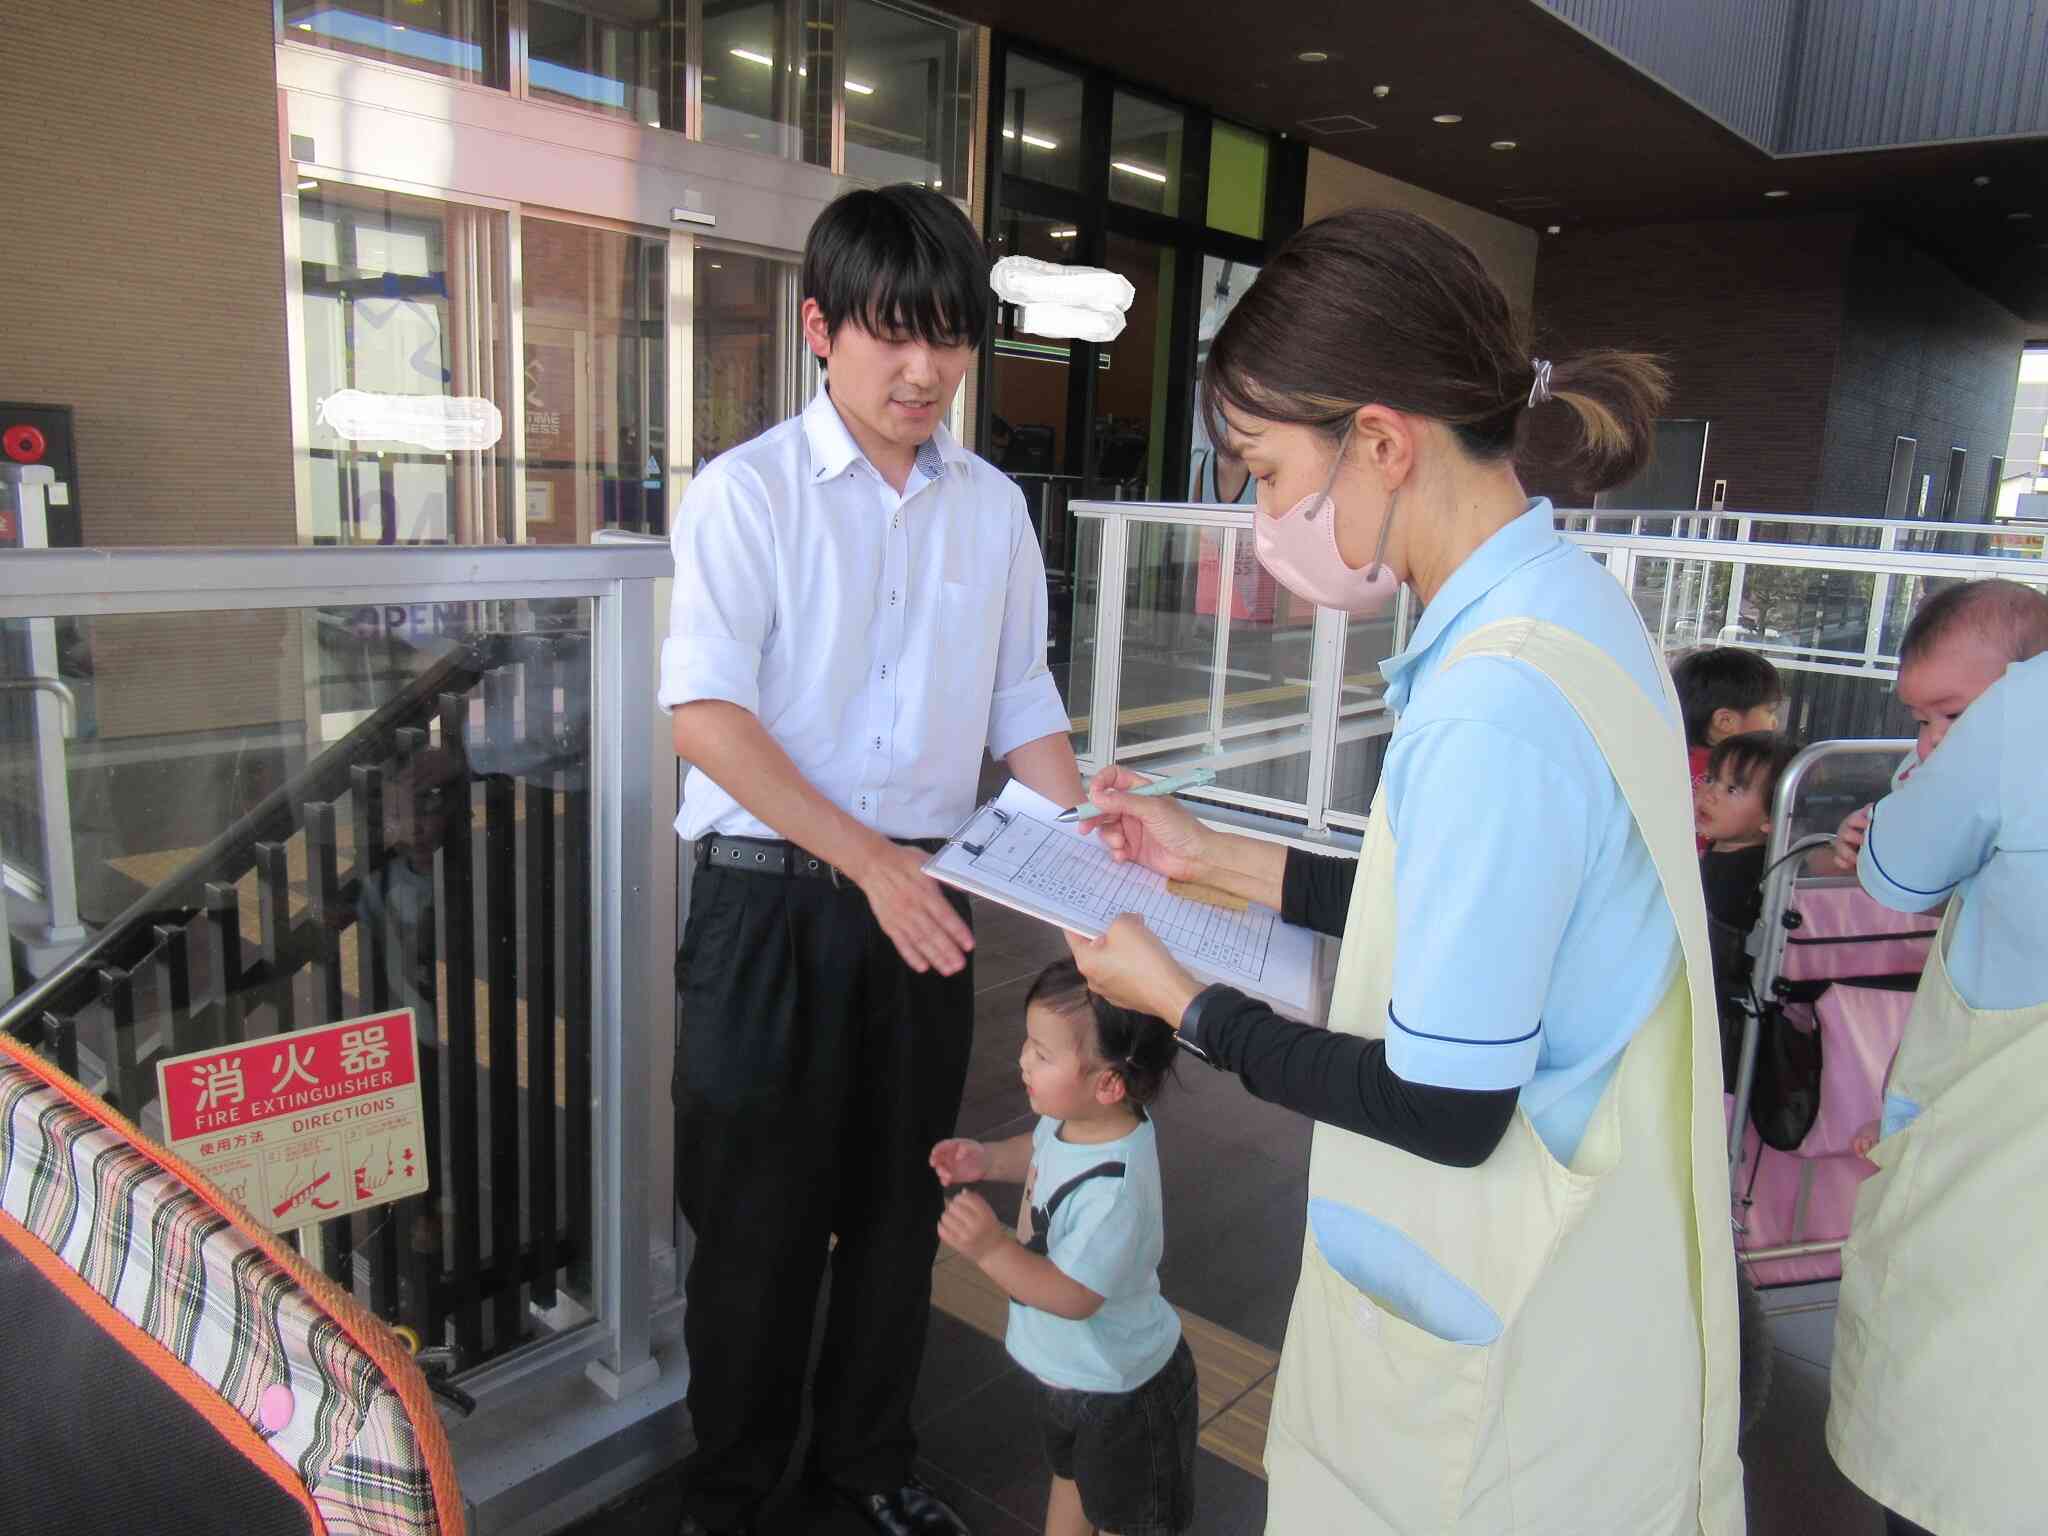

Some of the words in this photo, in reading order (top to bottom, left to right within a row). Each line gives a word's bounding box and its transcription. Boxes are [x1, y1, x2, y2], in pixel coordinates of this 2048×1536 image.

[191, 1026, 391, 1111] 消火器
[195, 1108, 241, 1130] FIRE
[251, 1071, 394, 1117] EXTINGUISHER
[292, 1097, 396, 1133] DIRECTIONS
[200, 1131, 265, 1157] 使用方法
